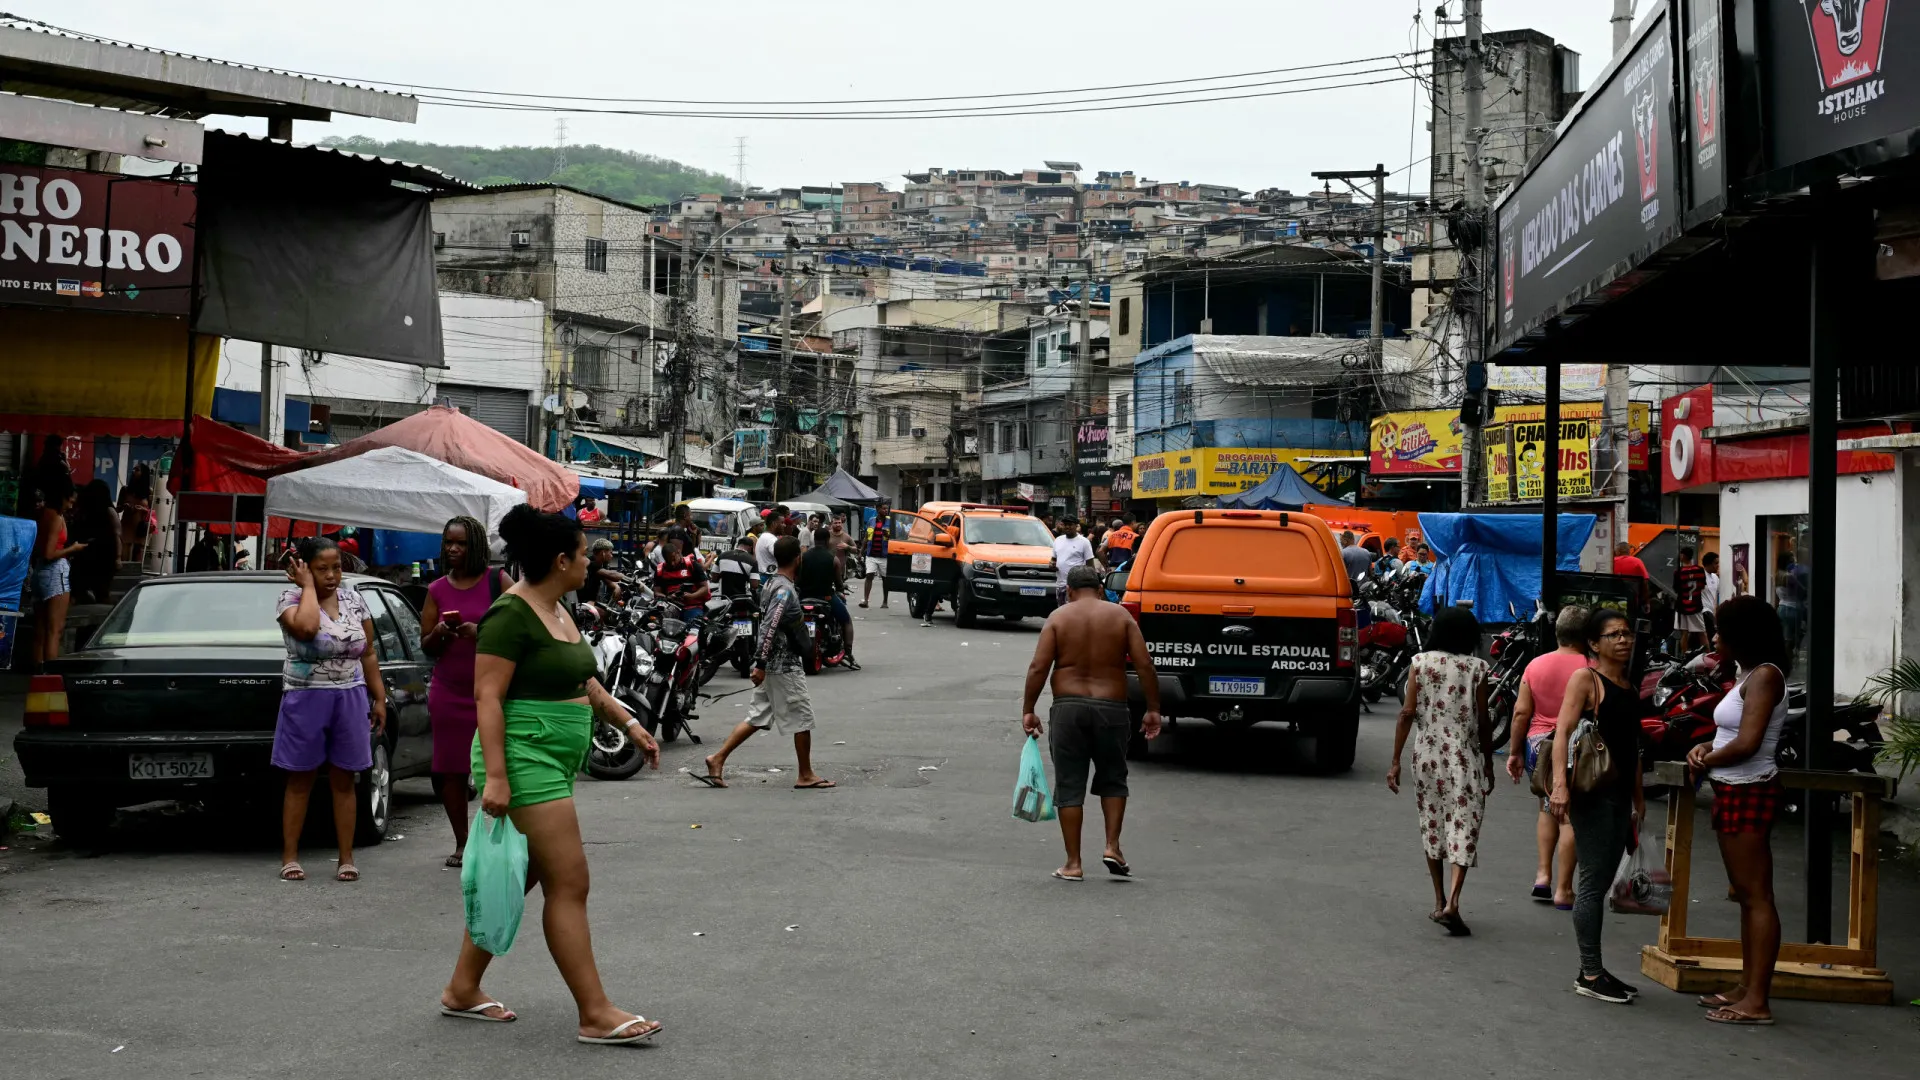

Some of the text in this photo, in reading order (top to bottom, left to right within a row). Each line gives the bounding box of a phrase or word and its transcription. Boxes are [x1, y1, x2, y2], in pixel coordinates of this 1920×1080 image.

[1824, 79, 1878, 115] STEAK
[1833, 105, 1867, 124] HOUSE
[1521, 195, 1558, 278] MERCADO
[1561, 173, 1580, 245] DAS
[1582, 130, 1625, 225] CARNES
[0, 219, 183, 273] NEIRO
[23, 281, 31, 289] E
[33, 281, 52, 291] PIX
[61, 283, 76, 291] VISA
[1516, 423, 1587, 443] CHAEIRO
[1217, 453, 1278, 463] DROGARIAS
[1541, 449, 1589, 472] 4hs
[906, 577, 935, 585] ARDC-032
[1155, 603, 1191, 613] DGDEC
[1146, 641, 1331, 658] DEFESA CIVIL ESTADUAL
[1150, 656, 1331, 671] BMERJ ARDC-031
[218, 678, 273, 686] CHEVROLET
[1213, 682, 1259, 694] LTX9H59
